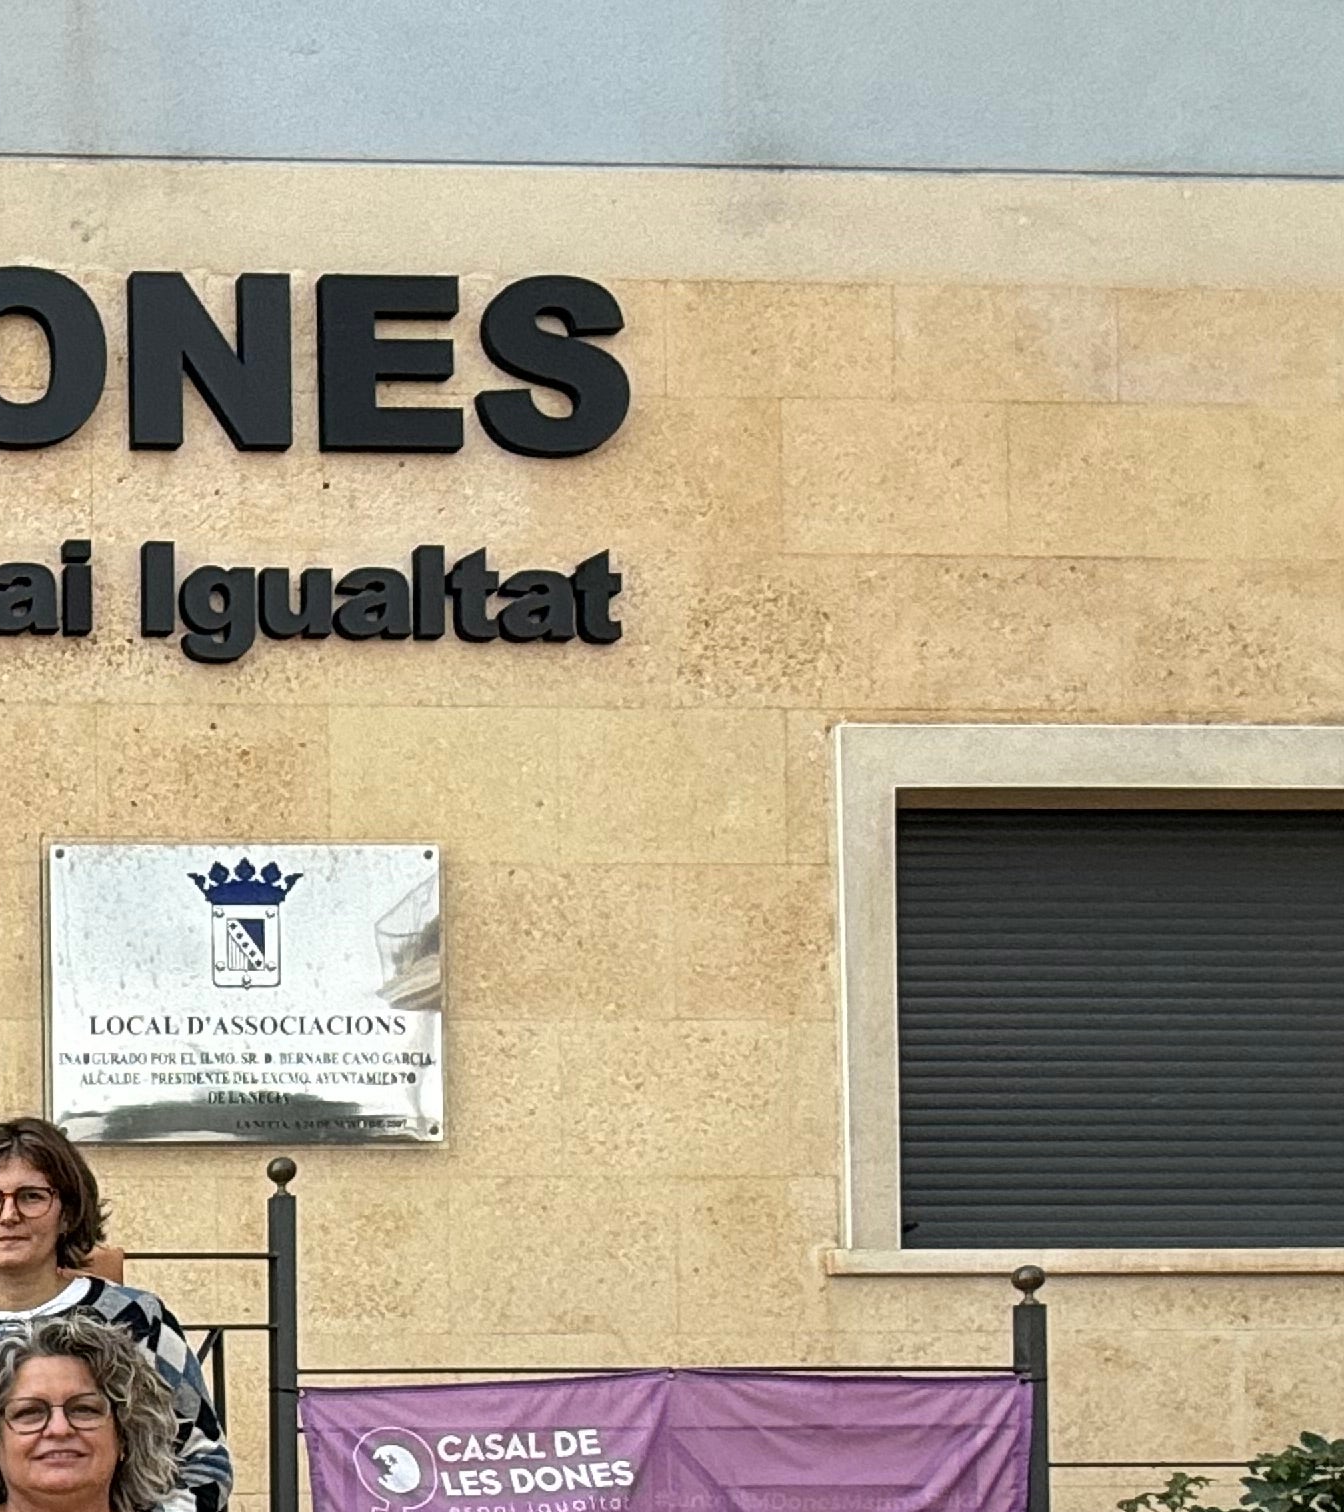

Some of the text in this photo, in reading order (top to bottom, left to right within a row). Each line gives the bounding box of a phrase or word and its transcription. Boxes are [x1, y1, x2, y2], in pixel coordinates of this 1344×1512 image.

[140, 540, 624, 663] Igualtat
[88, 1014, 407, 1036] LOCAL D'ASSOCIACIONS
[58, 1052, 147, 1065] INAUGURADO
[150, 1053, 176, 1065] POR
[180, 1053, 197, 1065] EL
[342, 1052, 380, 1065] CANO
[81, 1072, 141, 1086] ALCALDE
[150, 1072, 230, 1085] PRESIDENTE
[233, 1072, 258, 1085] DEL
[315, 1072, 417, 1085] AYUNTAMIENTO
[436, 1428, 602, 1463] CASAL DE
[440, 1460, 635, 1497] LES DONES
